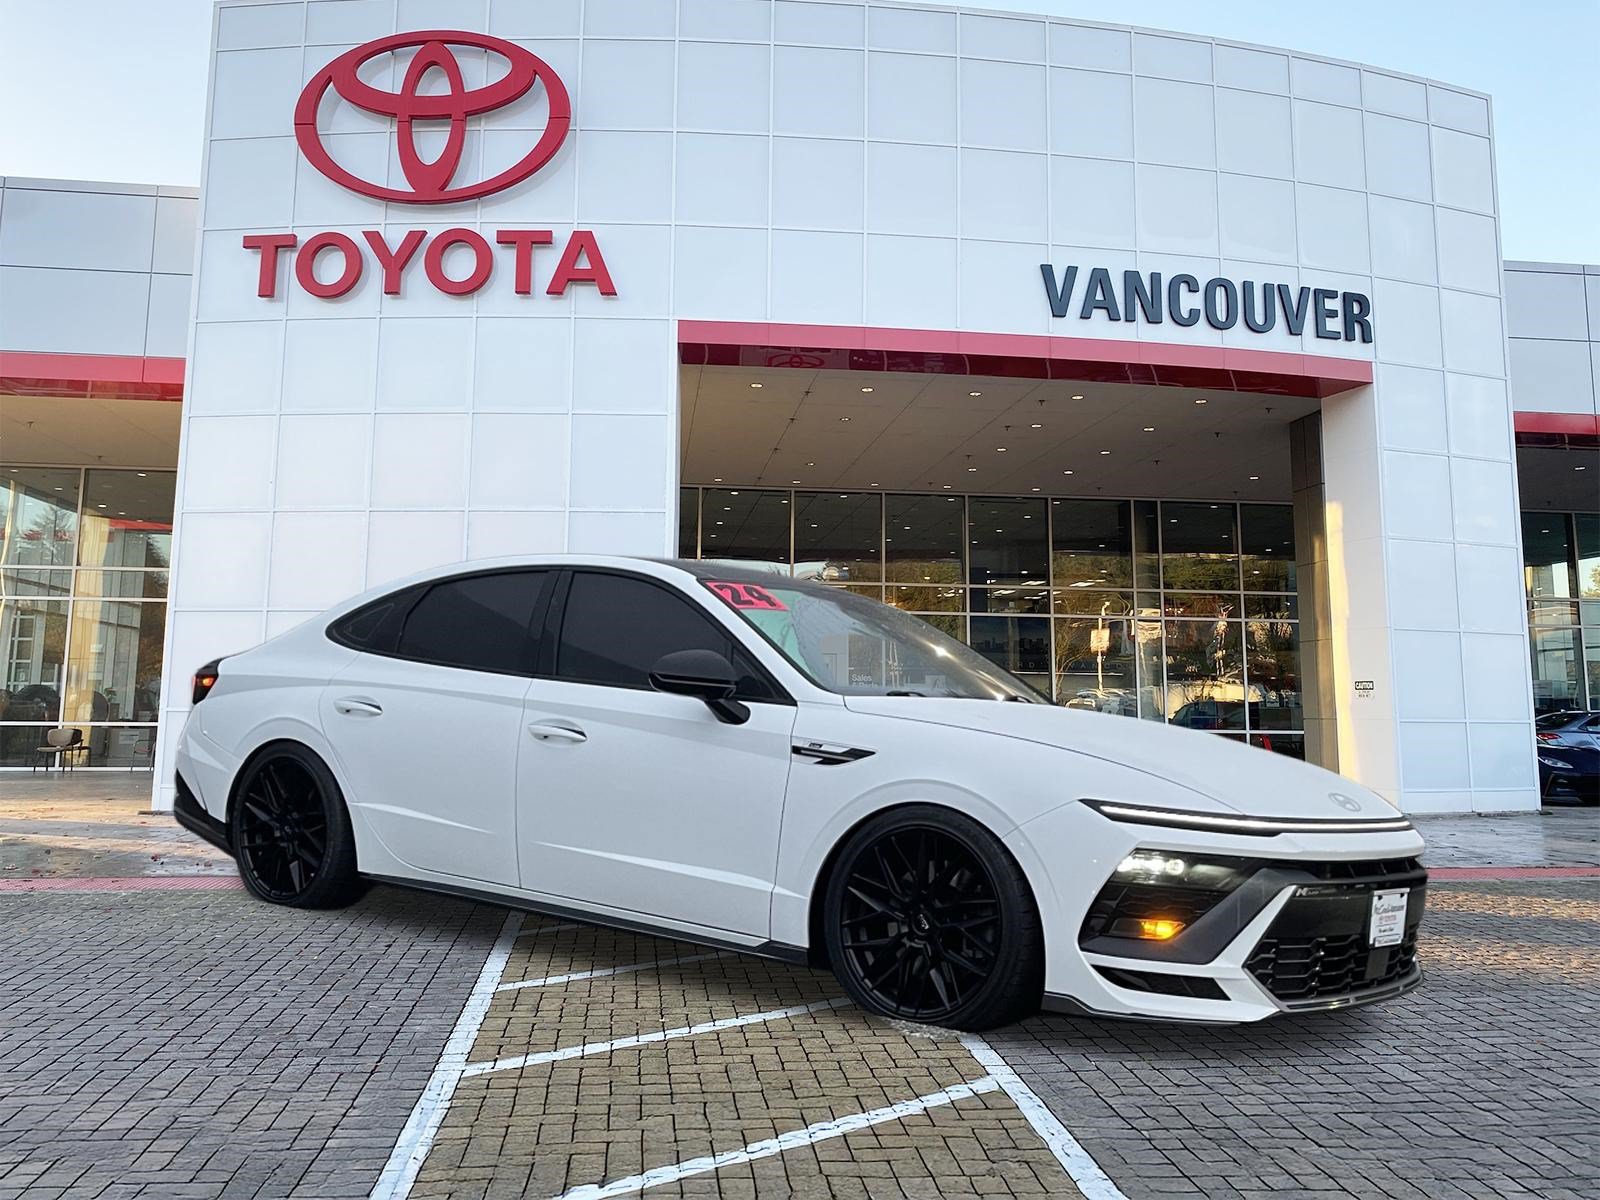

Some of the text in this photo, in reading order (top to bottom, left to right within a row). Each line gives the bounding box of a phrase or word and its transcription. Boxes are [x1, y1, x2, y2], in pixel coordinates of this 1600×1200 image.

[242, 228, 618, 299] TOYOTA
[1040, 263, 1374, 344] VANCOUVER
[851, 673, 872, 683] Sales
